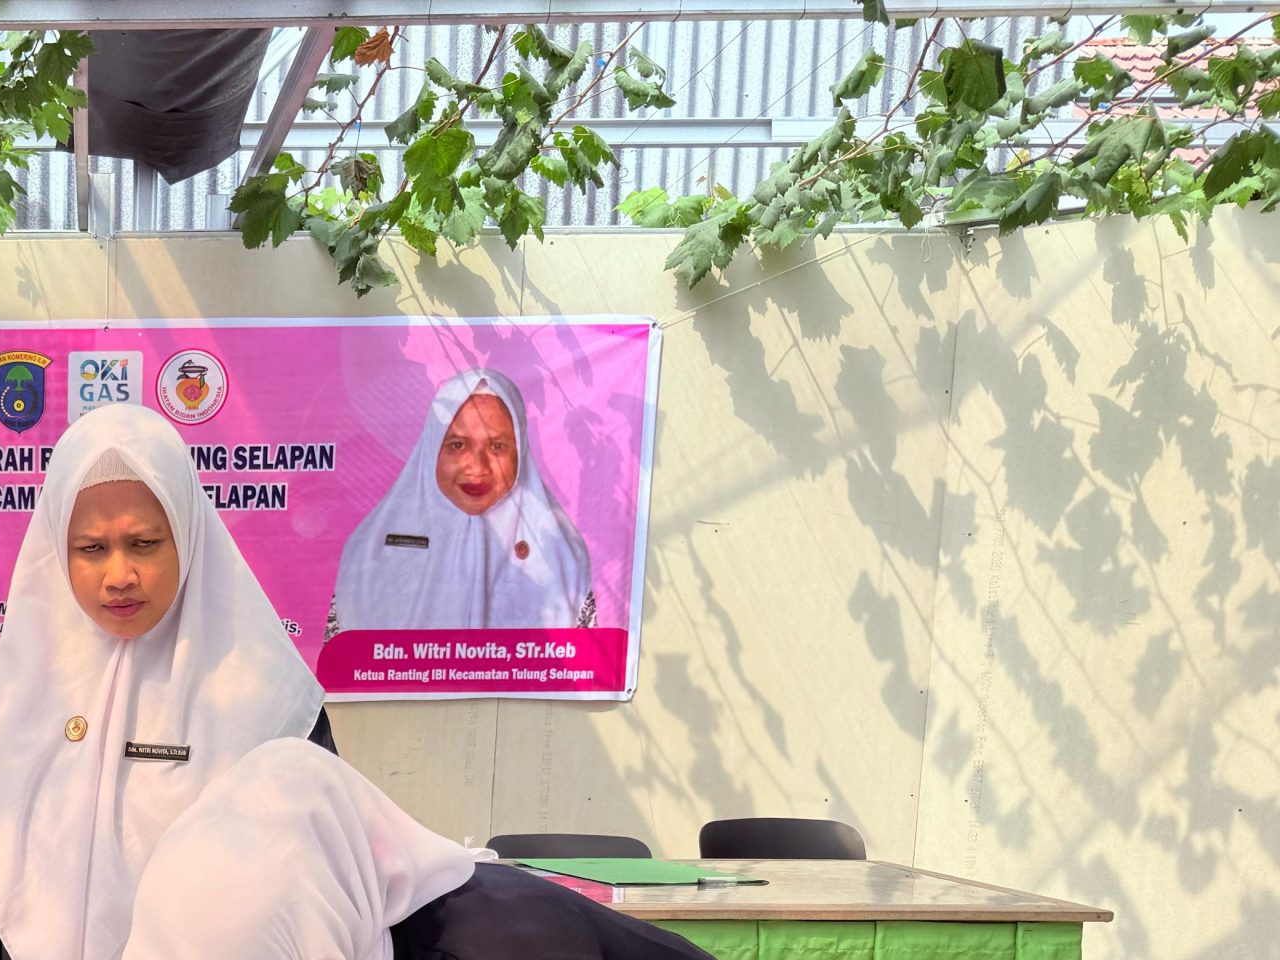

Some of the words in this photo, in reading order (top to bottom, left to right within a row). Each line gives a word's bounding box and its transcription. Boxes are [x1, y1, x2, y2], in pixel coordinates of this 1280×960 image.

[7, 353, 36, 362] KOMERING
[79, 358, 129, 381] OKI
[79, 383, 130, 402] GAS
[162, 386, 175, 411] IKATAN
[175, 408, 196, 419] BIDAN
[197, 386, 223, 417] INDONESIA
[233, 445, 334, 470] SELAPAN
[373, 643, 409, 660] Bdn.
[413, 642, 451, 659] Witri
[455, 642, 511, 662] Novita,
[515, 642, 576, 659] STr.Keb
[353, 669, 385, 681] Ketua
[387, 669, 429, 682] Ranting
[431, 669, 446, 680] IBI
[448, 669, 509, 680] Kecamatan
[511, 668, 547, 682] Tulung
[549, 668, 594, 681] Selapan
